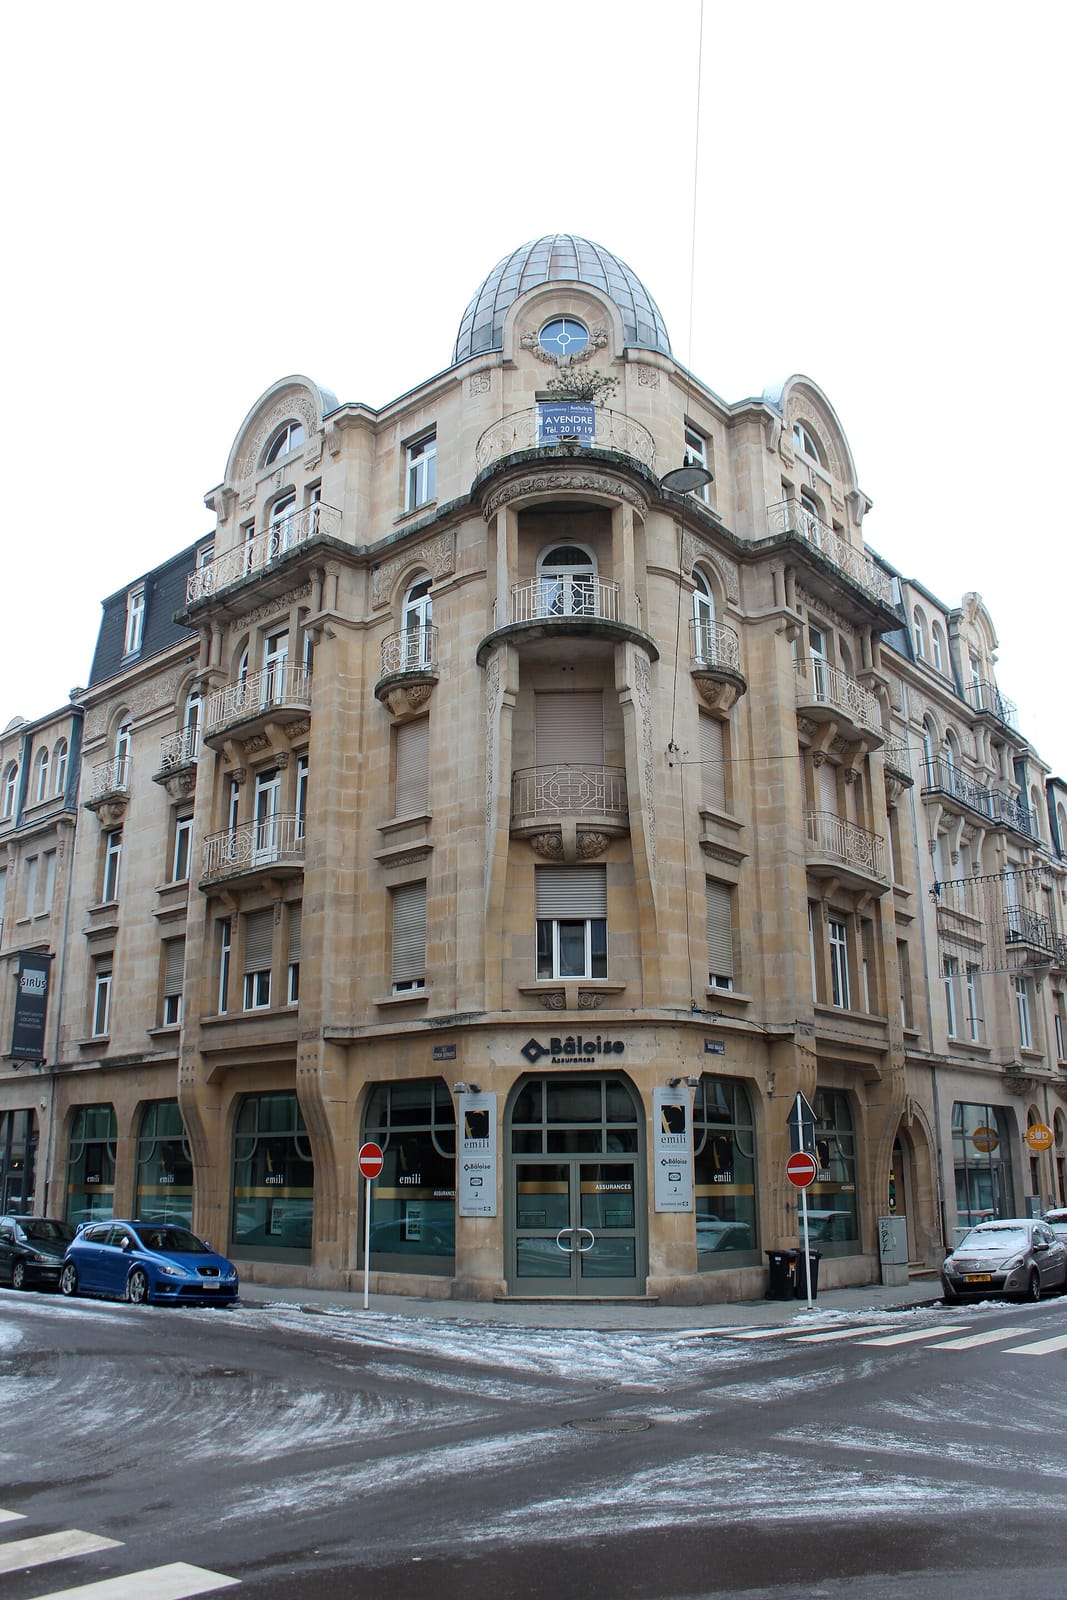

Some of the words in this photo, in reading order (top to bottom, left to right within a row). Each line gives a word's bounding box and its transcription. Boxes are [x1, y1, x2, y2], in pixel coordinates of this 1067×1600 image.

[553, 416, 593, 424] VENDRE
[560, 425, 570, 433] 20
[573, 425, 582, 433] 19
[550, 1035, 625, 1055] Bâloise
[551, 1056, 595, 1064] Assurances
[464, 1139, 490, 1149] emili
[661, 1134, 686, 1144] emili
[159, 1174, 175, 1183] emili
[265, 1173, 284, 1184] emili
[399, 1173, 421, 1184] emili
[713, 1171, 732, 1183] emili
